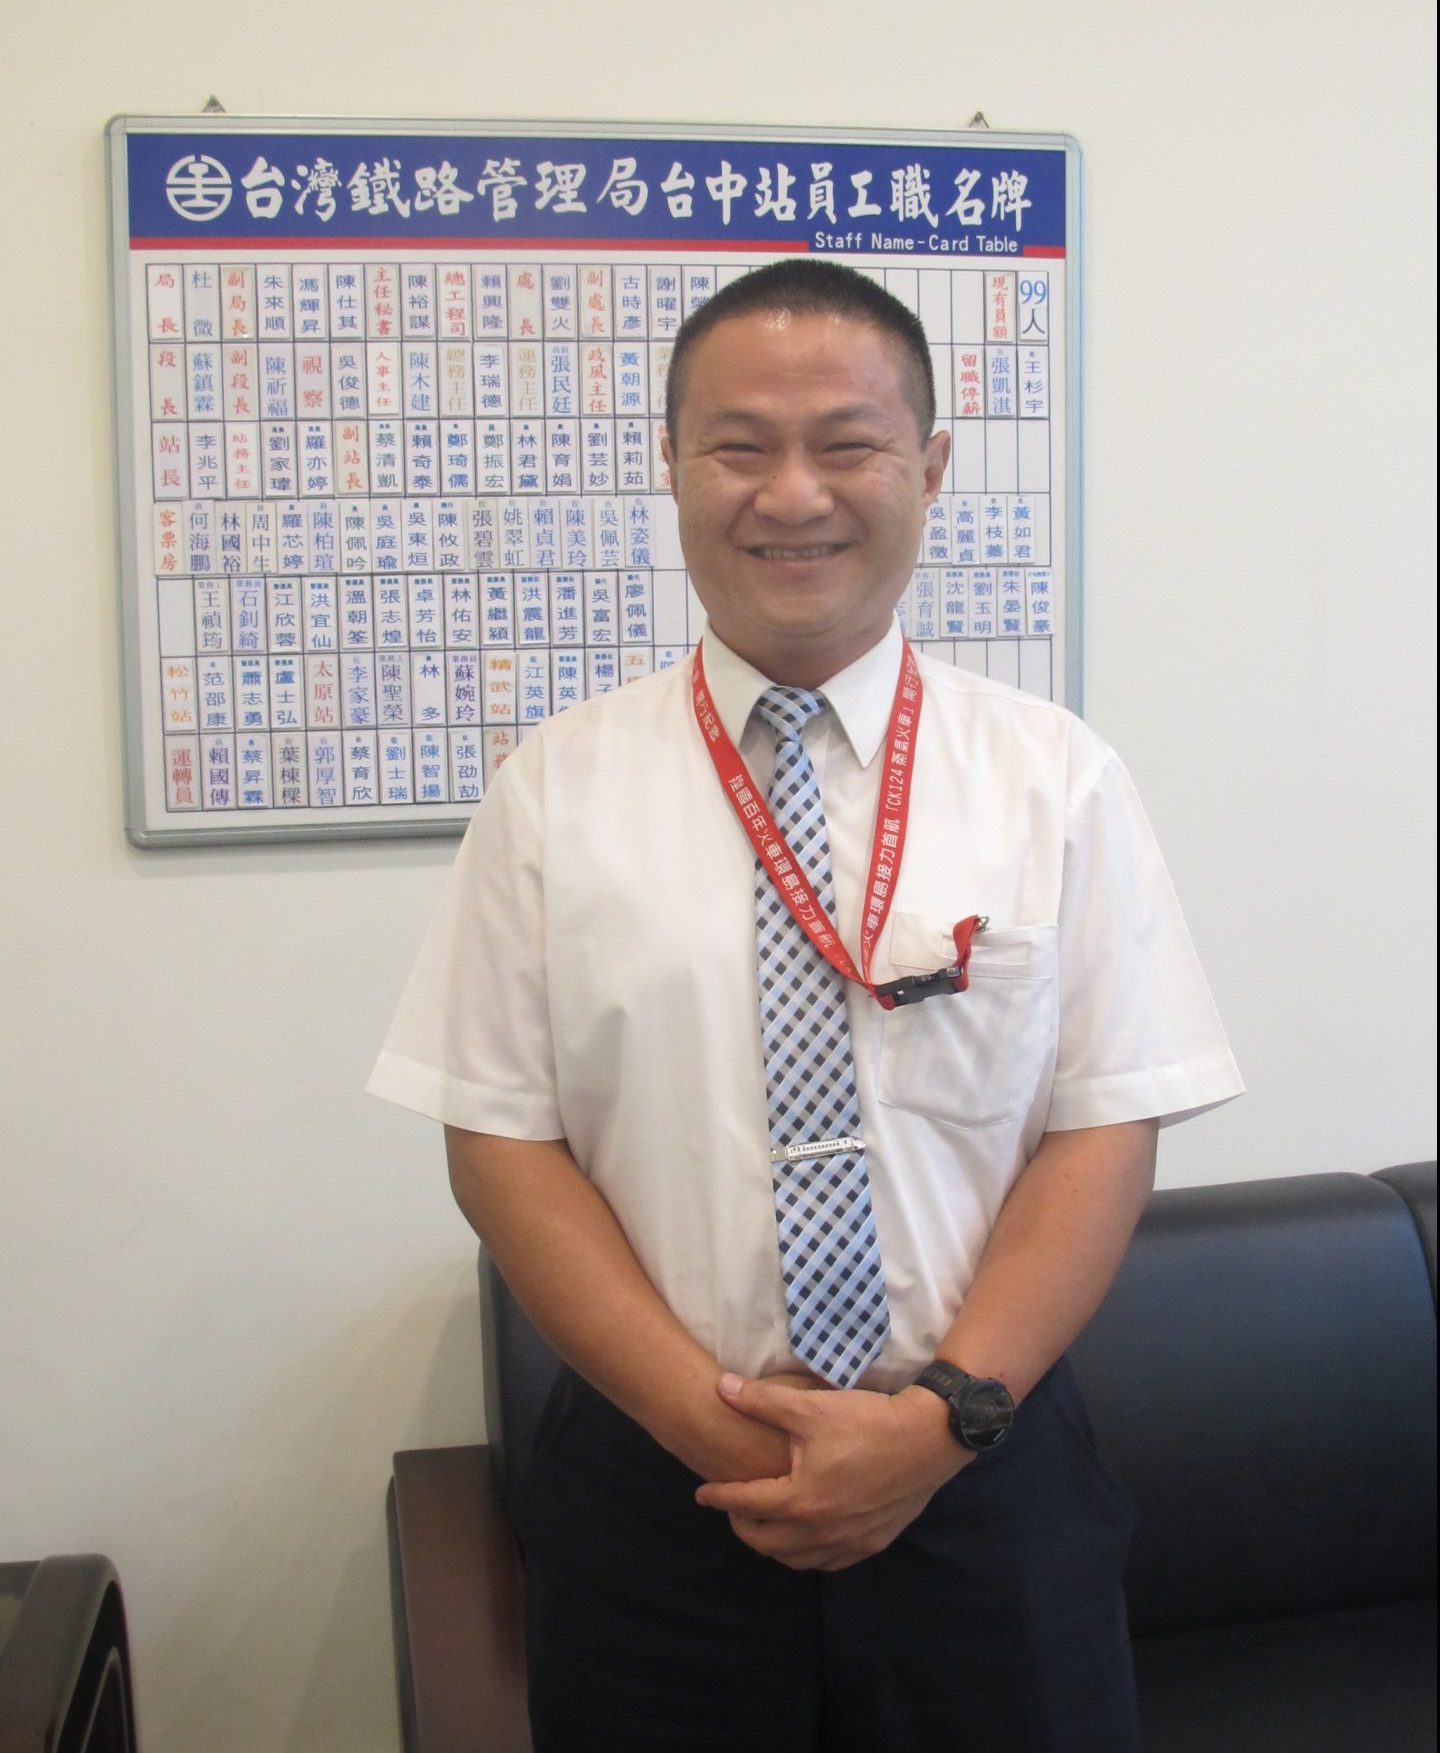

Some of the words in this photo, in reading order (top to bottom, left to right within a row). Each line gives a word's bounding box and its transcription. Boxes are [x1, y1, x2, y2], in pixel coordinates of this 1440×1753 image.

[239, 155, 1033, 231] 台灣鐵路管理局台中站員工職名牌
[814, 231, 864, 249] Staff
[871, 233, 969, 252] Name-Card
[976, 235, 1018, 253] Table
[227, 271, 249, 335] 副局長
[264, 275, 286, 330] 朱來順
[373, 267, 393, 336] 主任秘書
[374, 351, 393, 408] 人事主任
[409, 352, 431, 412] 陳木建
[479, 354, 502, 409] 李瑞德
[960, 354, 981, 415] 留職停薪
[159, 435, 182, 487] 站長
[196, 435, 219, 490] 李兆平
[342, 425, 363, 490] 副站長
[158, 510, 178, 570] 客票房
[166, 666, 192, 723] 松竹站
[313, 660, 335, 724] 太原站
